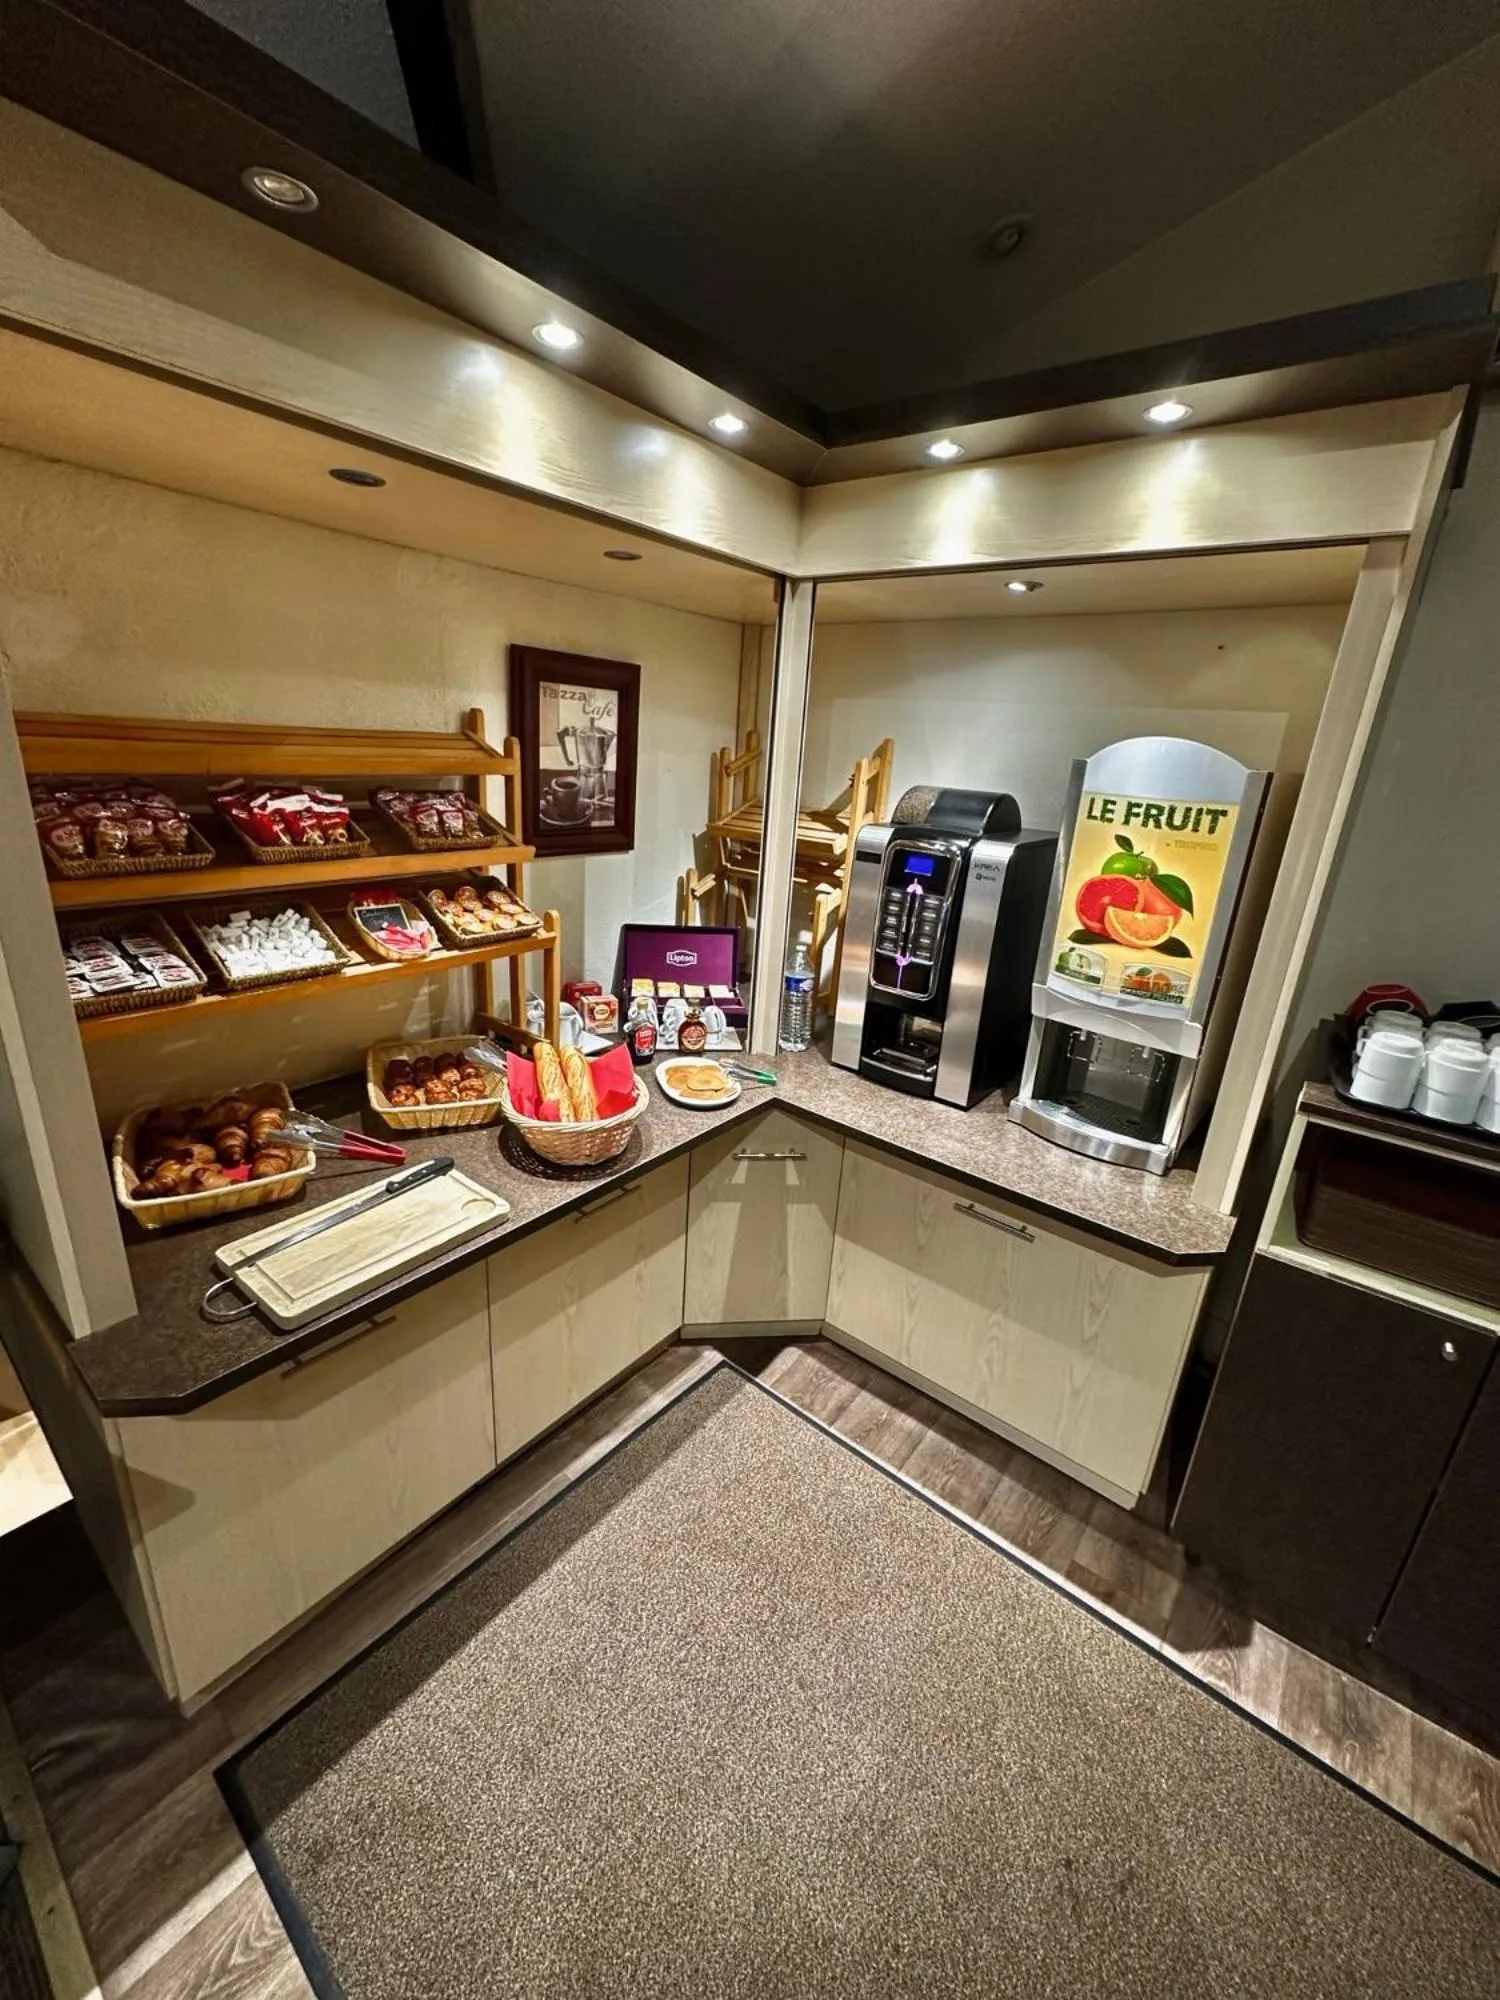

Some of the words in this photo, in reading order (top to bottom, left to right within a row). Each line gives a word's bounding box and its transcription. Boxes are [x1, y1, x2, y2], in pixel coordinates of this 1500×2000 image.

[541, 685, 587, 702] Tazza
[1086, 797, 1117, 824] LE
[1121, 800, 1228, 835] FRUIT
[668, 953, 694, 964] Lipton
